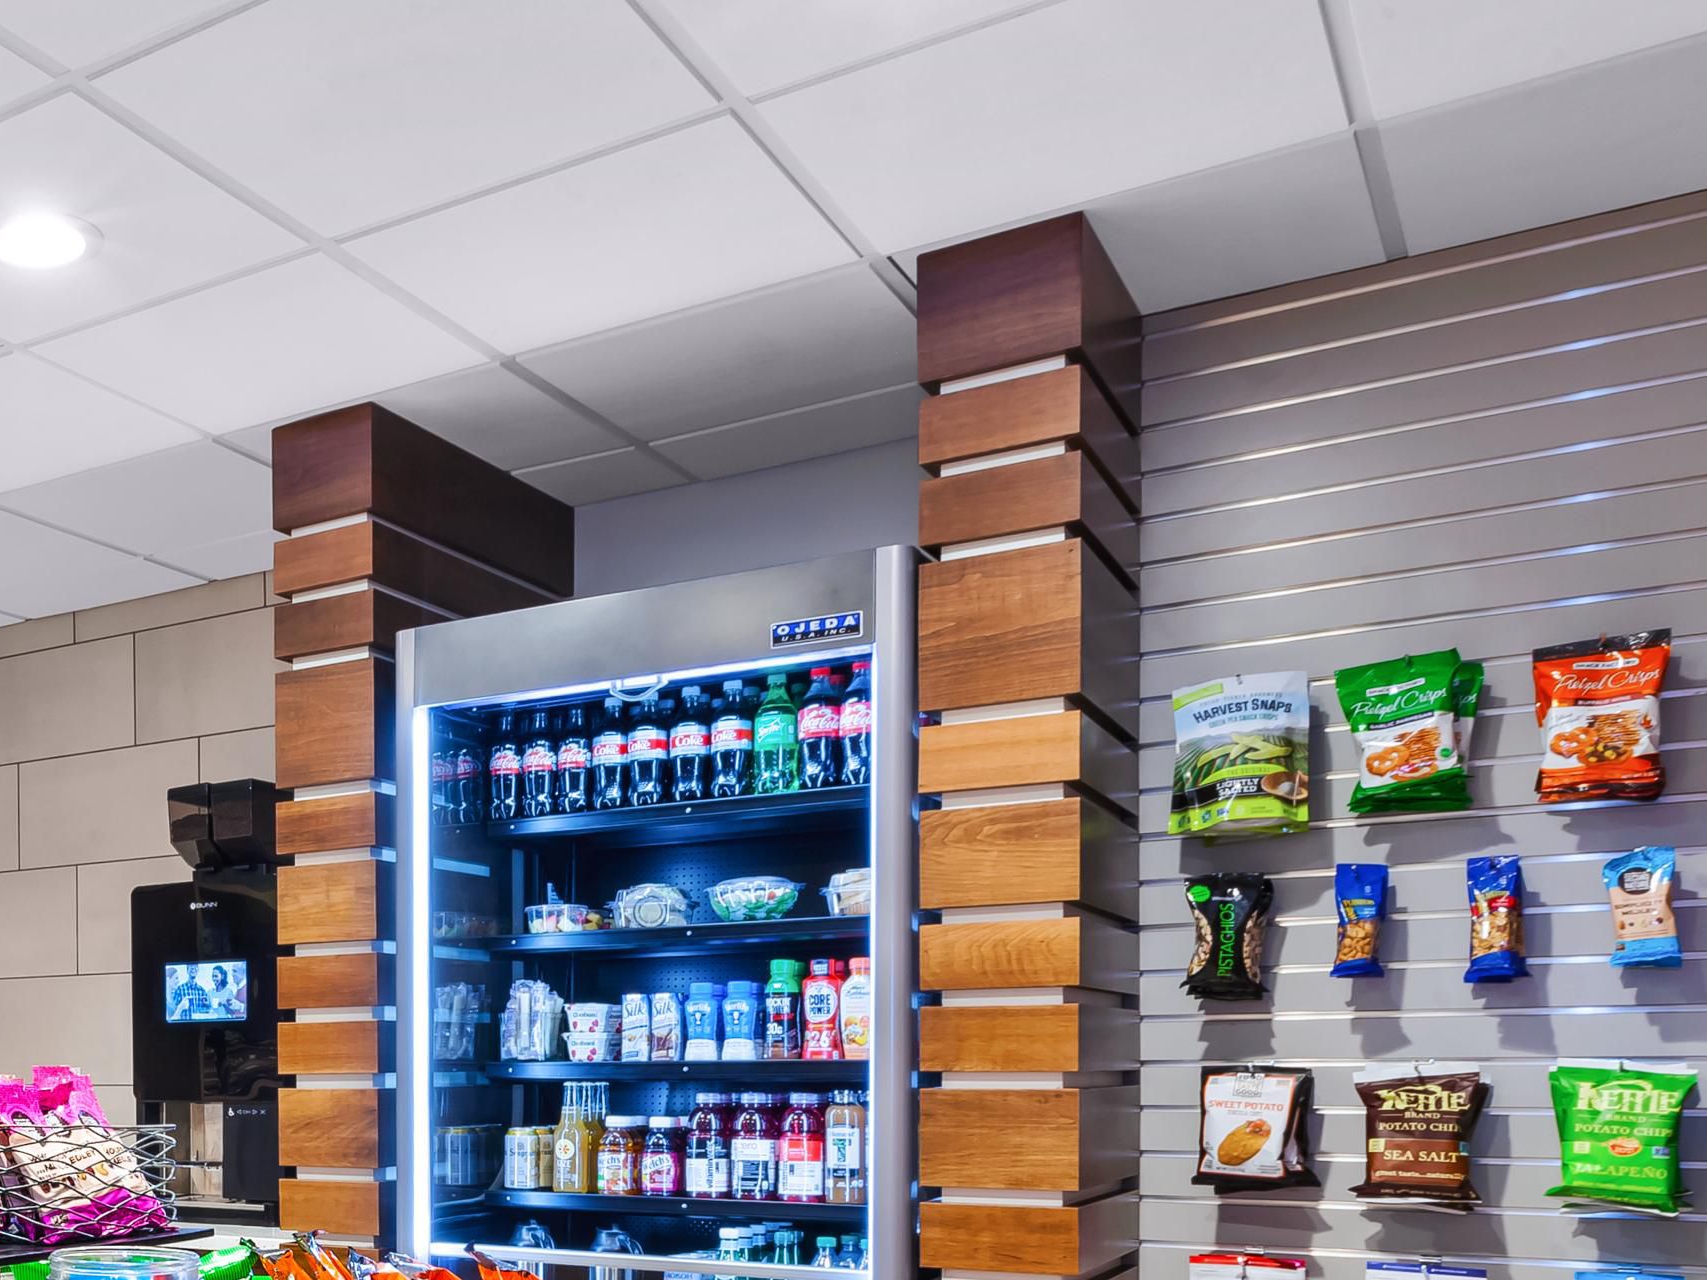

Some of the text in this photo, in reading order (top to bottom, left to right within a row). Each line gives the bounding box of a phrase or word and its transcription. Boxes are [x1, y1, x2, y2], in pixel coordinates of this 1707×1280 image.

[1554, 669, 1660, 696] Pretzel Crisps
[1193, 700, 1249, 723] HARVEST
[1251, 698, 1292, 713] SNAPS
[1350, 688, 1447, 720] Pretzel Crisps
[675, 734, 703, 746] Coke
[711, 730, 737, 744] Coke
[594, 744, 619, 756] Coke
[628, 740, 650, 752] Coke
[1216, 778, 1259, 790] LIGHTLY
[1217, 903, 1236, 977] PISTACHIOS
[808, 994, 831, 1006] CORE
[624, 1002, 645, 1018] Silk
[654, 1001, 673, 1016] Silk
[809, 1007, 831, 1015] POWER
[1209, 1099, 1284, 1112] SWEET POTATO
[1378, 1122, 1461, 1132] POTATO CHIP
[1574, 1123, 1630, 1134] POTATO
[1383, 1149, 1459, 1163] SEA SALT
